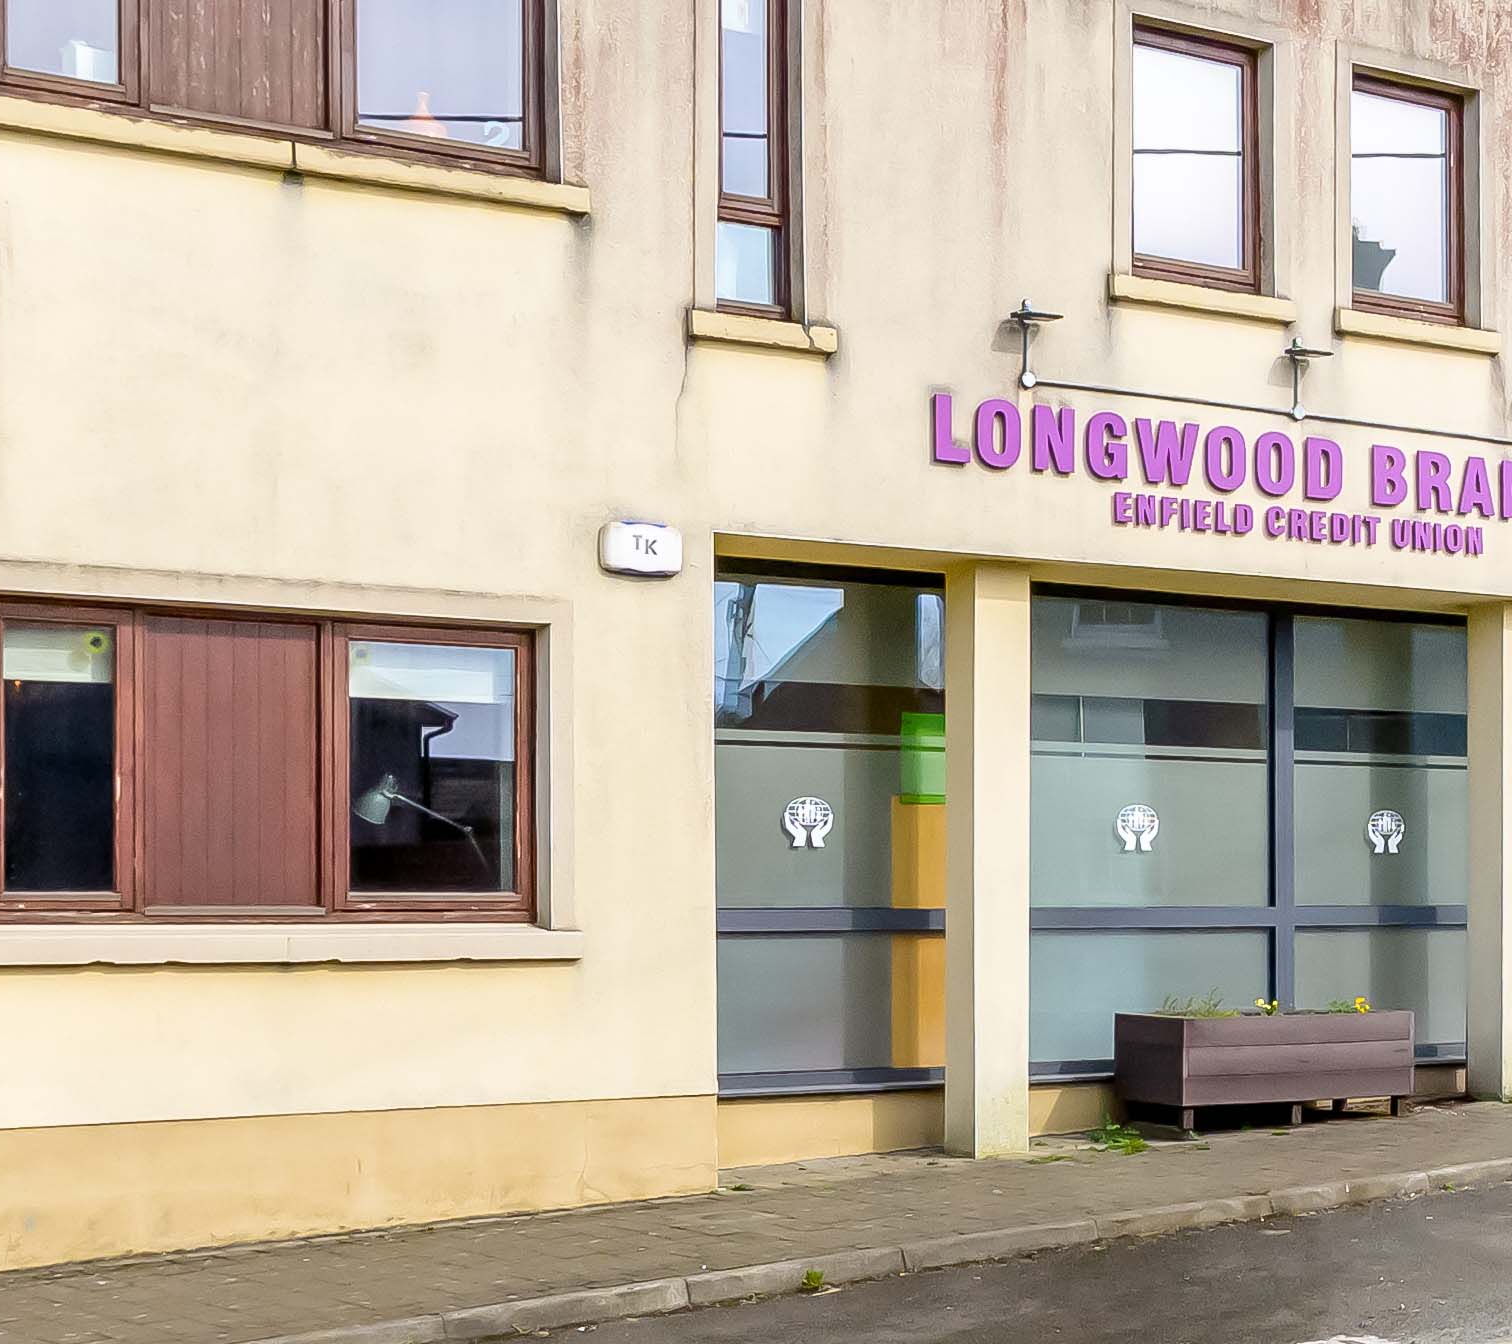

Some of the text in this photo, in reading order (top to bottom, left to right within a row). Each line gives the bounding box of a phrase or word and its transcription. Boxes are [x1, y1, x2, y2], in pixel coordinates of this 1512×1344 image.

[932, 393, 1344, 501] LONGWOOD
[632, 534, 658, 556] TK
[1113, 491, 1484, 555] ENFIELD CREDIT UNION
